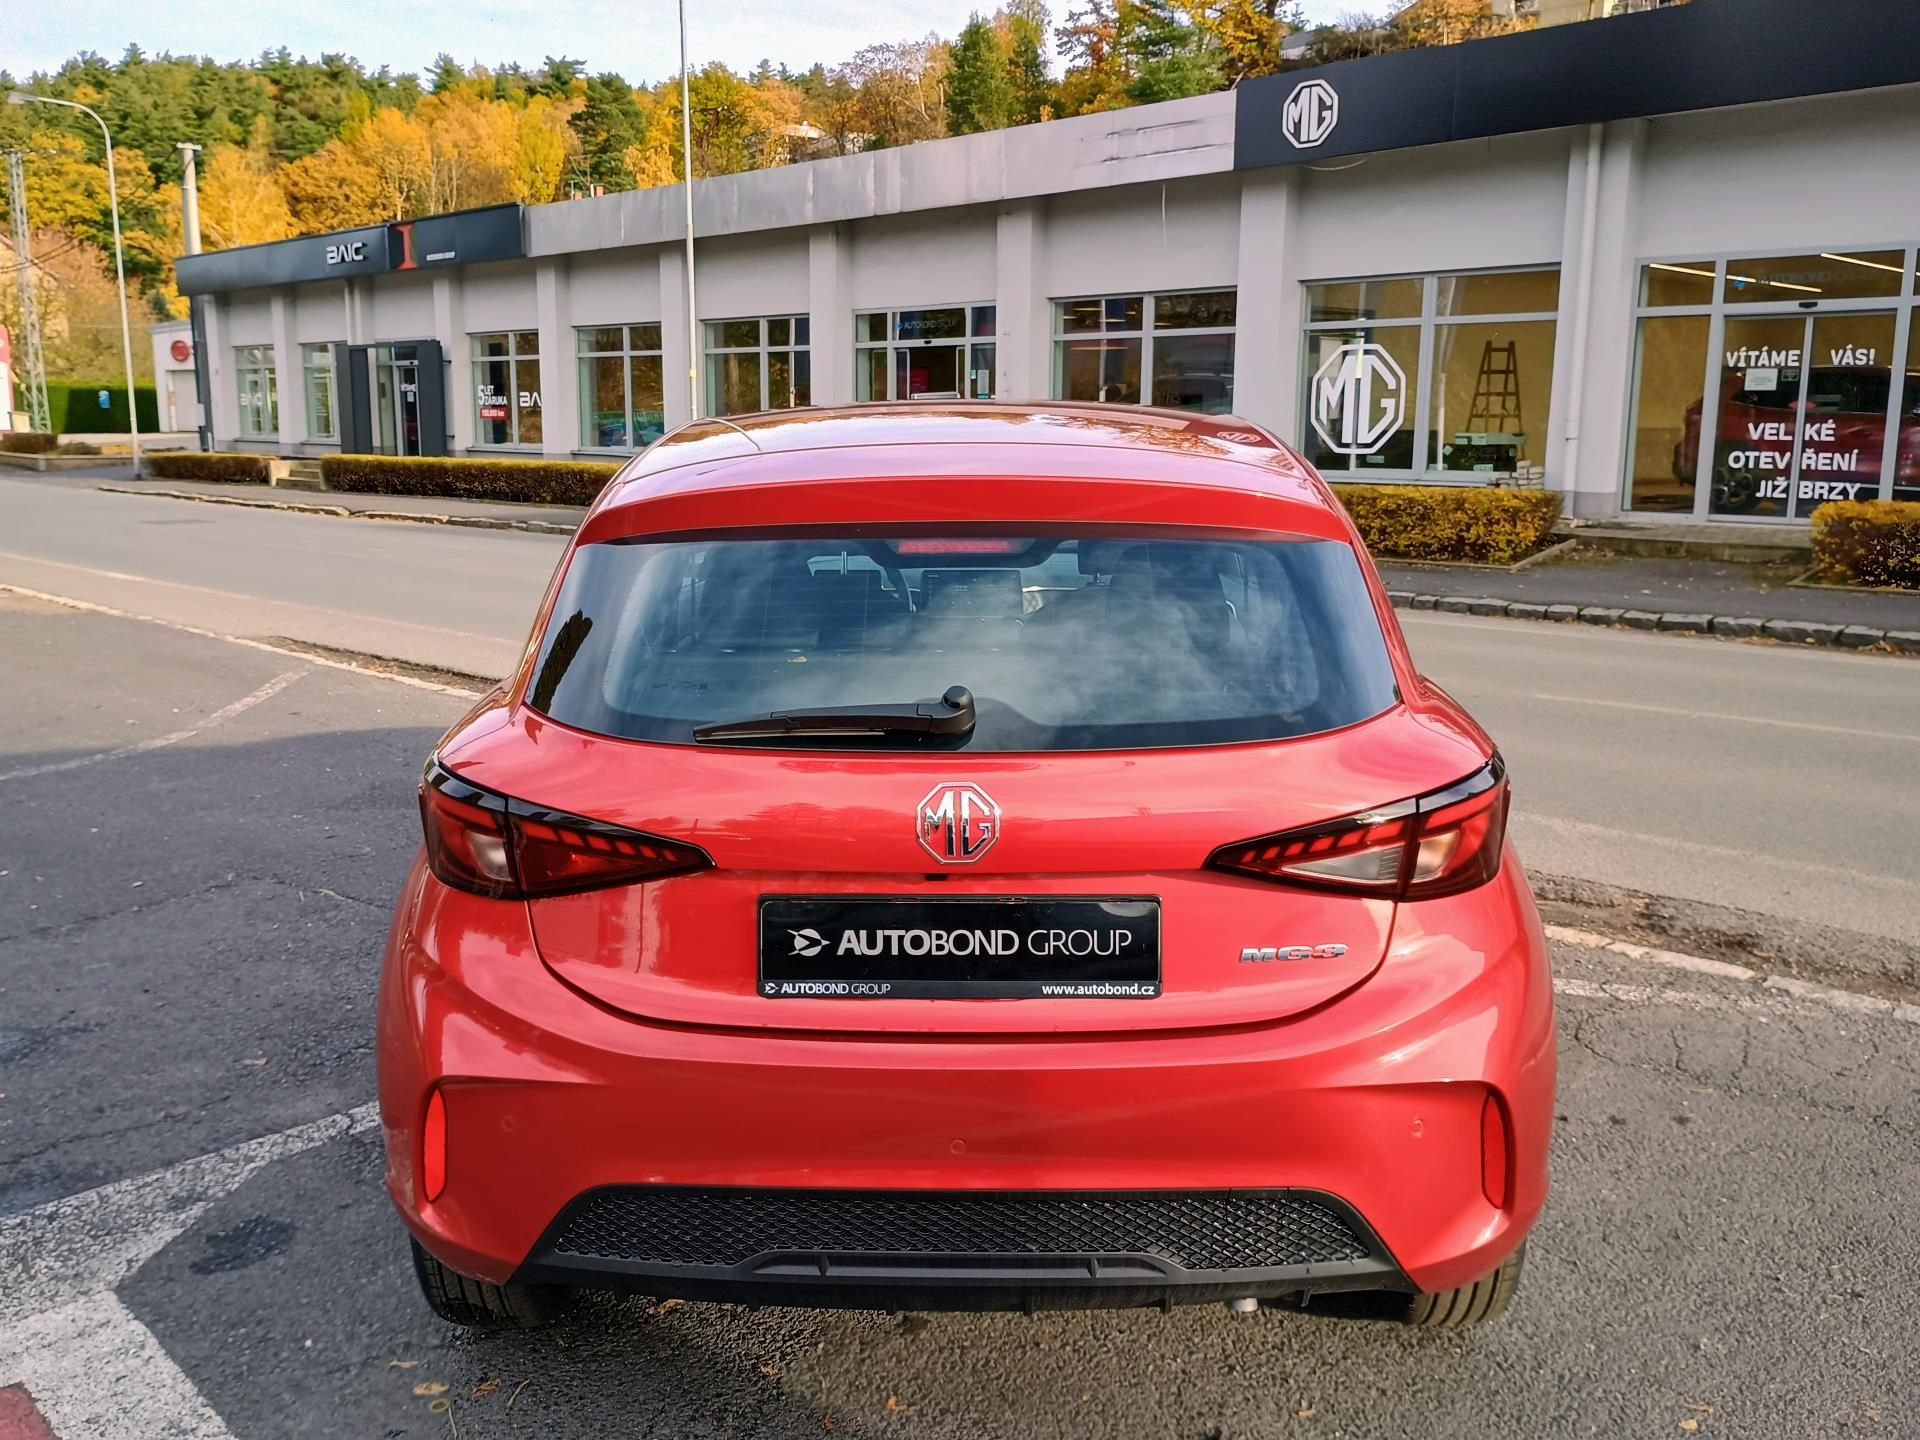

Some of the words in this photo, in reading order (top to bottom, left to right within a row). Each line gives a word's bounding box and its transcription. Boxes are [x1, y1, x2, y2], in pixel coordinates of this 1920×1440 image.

[1286, 85, 1334, 143] MG
[1726, 346, 1800, 367] VÍTÁME
[1830, 344, 1875, 366] VÁS!
[1317, 353, 1398, 446] MG
[1755, 477, 1789, 499] JIŽ
[1798, 481, 1861, 501] BRZY
[922, 787, 995, 860] MG
[836, 929, 1020, 956] AUTOBOND
[1027, 929, 1132, 956] GROUP
[1240, 943, 1349, 962] MG3
[780, 983, 849, 994] AUTOBOND
[851, 983, 891, 995] GROUP
[1041, 983, 1155, 996] www.autobond.cz
